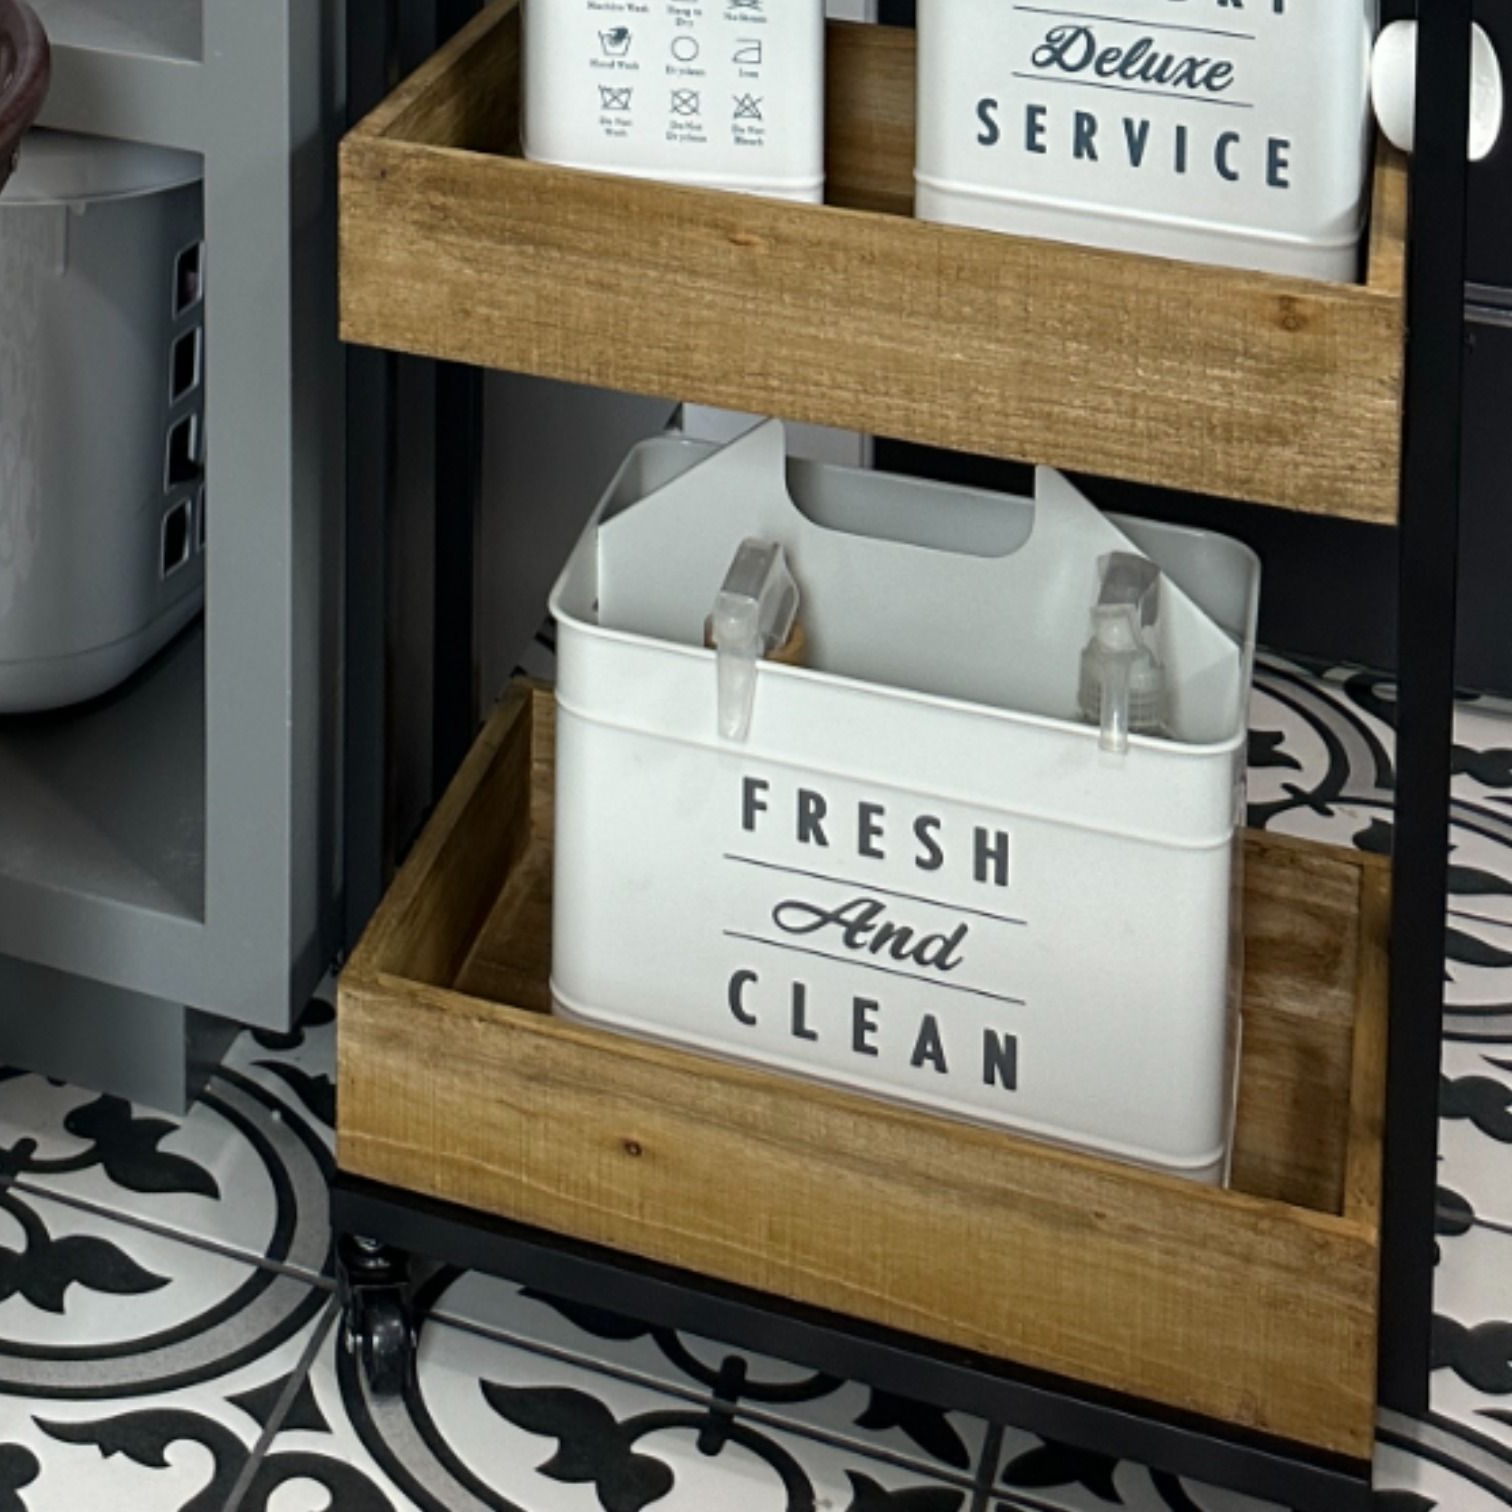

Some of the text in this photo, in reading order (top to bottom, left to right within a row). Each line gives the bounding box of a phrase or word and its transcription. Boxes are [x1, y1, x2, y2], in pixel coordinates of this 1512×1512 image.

[1030, 23, 1236, 93] Deluxe
[975, 97, 1292, 190] SERVICE
[741, 776, 1011, 888] FRESH
[771, 896, 970, 973] And
[726, 968, 1020, 1093] CLEAN
